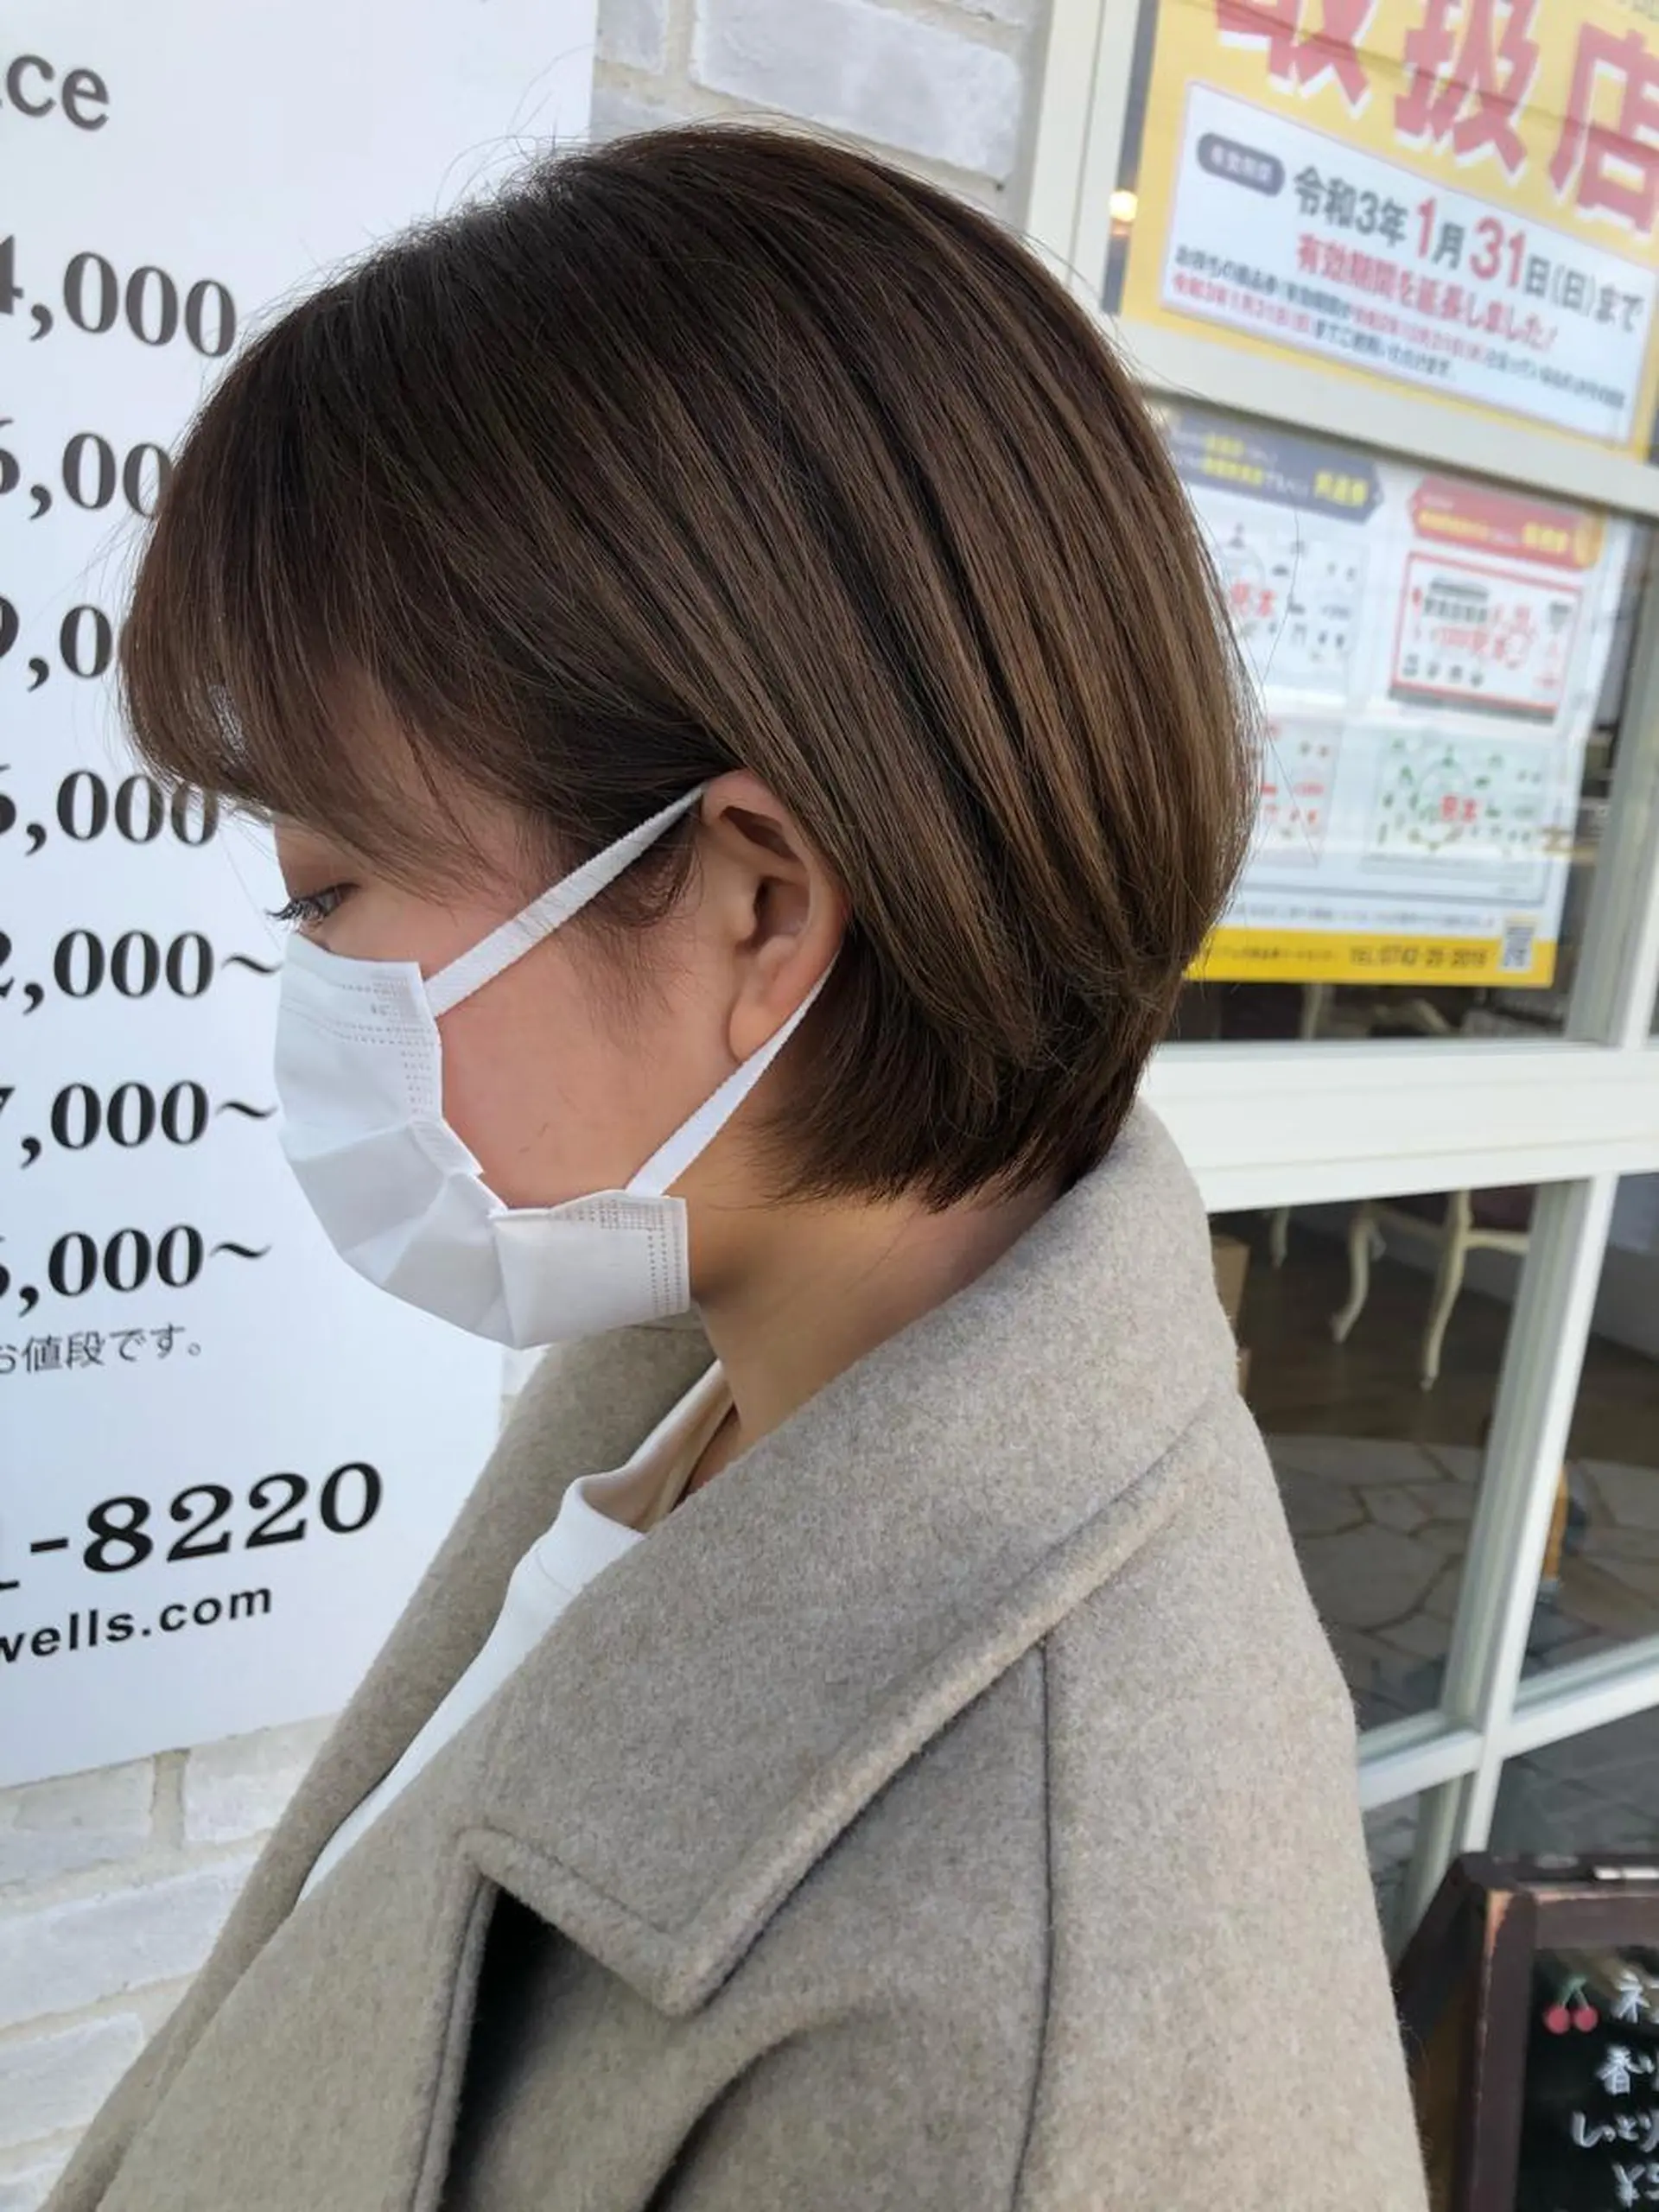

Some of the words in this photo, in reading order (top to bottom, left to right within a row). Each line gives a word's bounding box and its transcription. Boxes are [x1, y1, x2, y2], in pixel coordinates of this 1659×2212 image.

[0, 54, 109, 131] ce
[0, 929, 283, 1015] ,000~
[0, 1224, 272, 1318] ,000~
[0, 1462, 382, 1590] -8220
